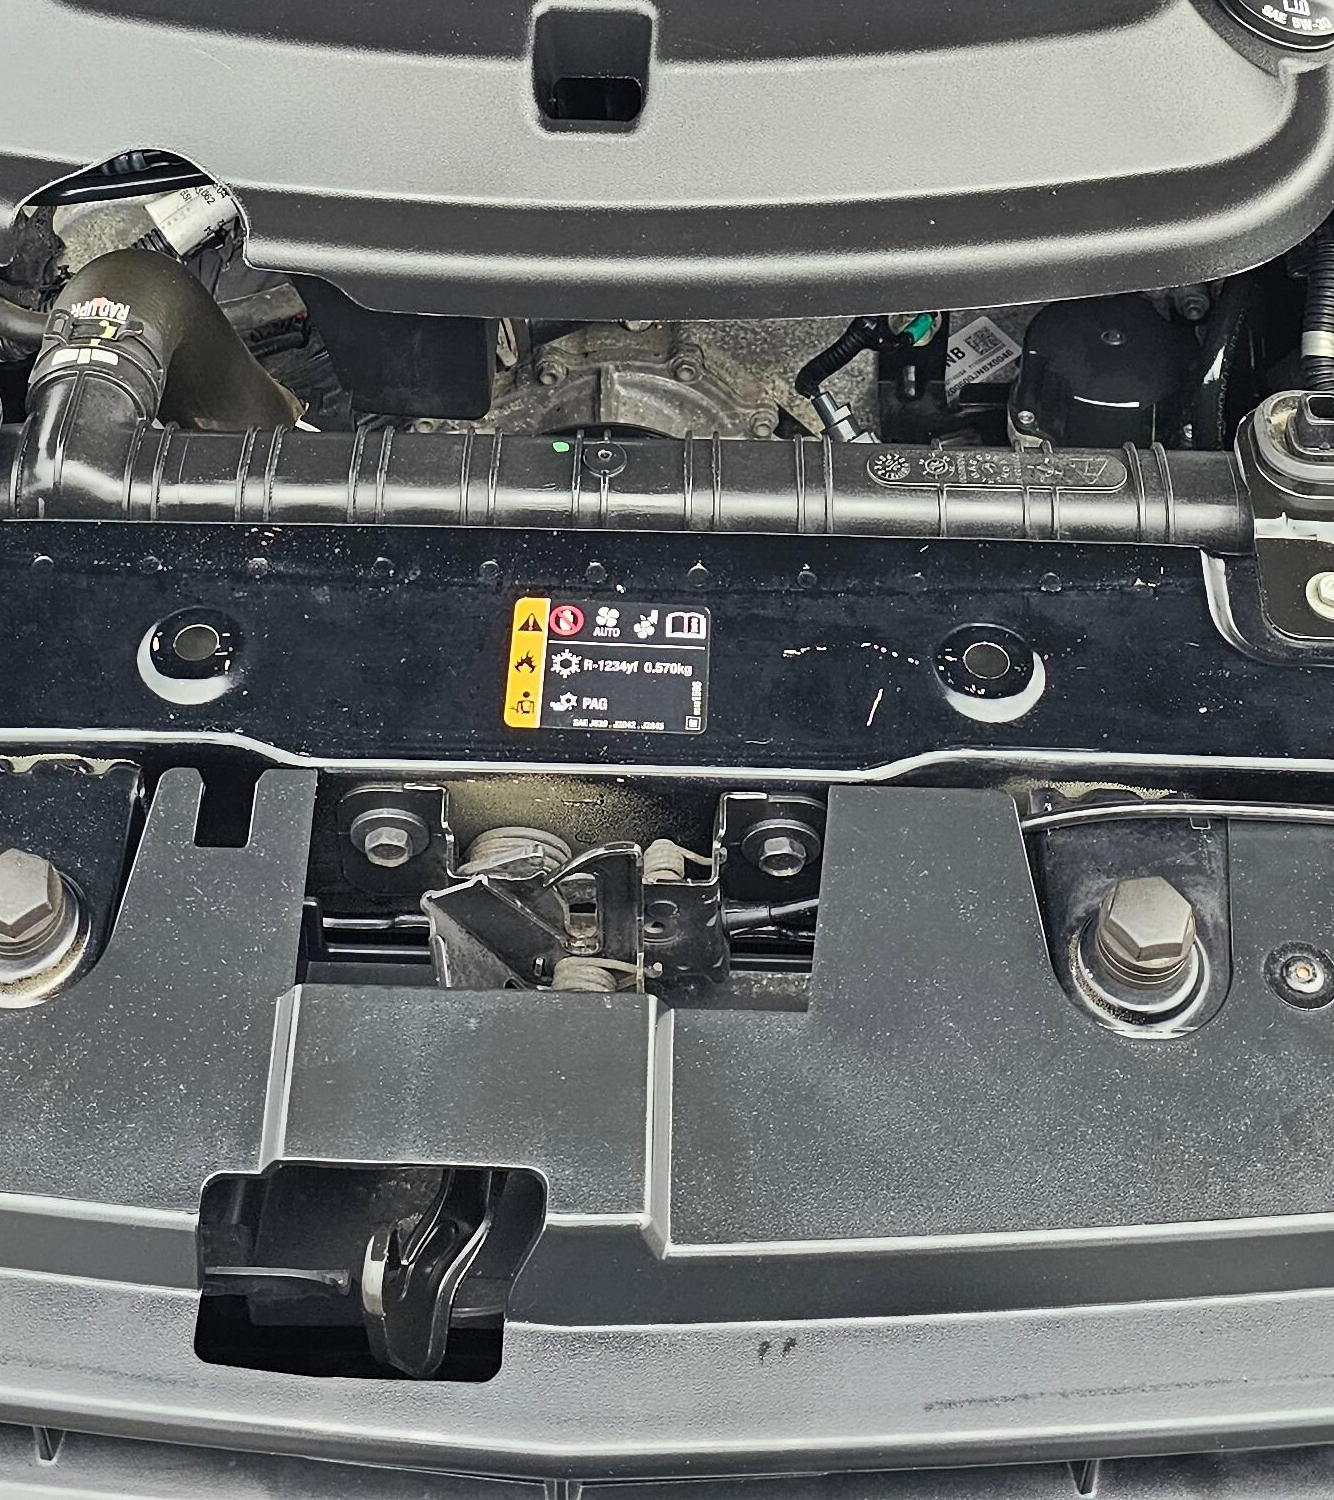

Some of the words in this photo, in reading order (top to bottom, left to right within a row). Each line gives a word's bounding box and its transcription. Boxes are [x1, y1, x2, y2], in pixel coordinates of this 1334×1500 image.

[1261, 4, 1288, 25] SAE
[1291, 16, 1333, 31] 5W-30
[592, 626, 621, 638] AUTO
[583, 658, 639, 675] R-1234yf
[643, 661, 693, 677] 0.570kg
[582, 696, 608, 711] PAG
